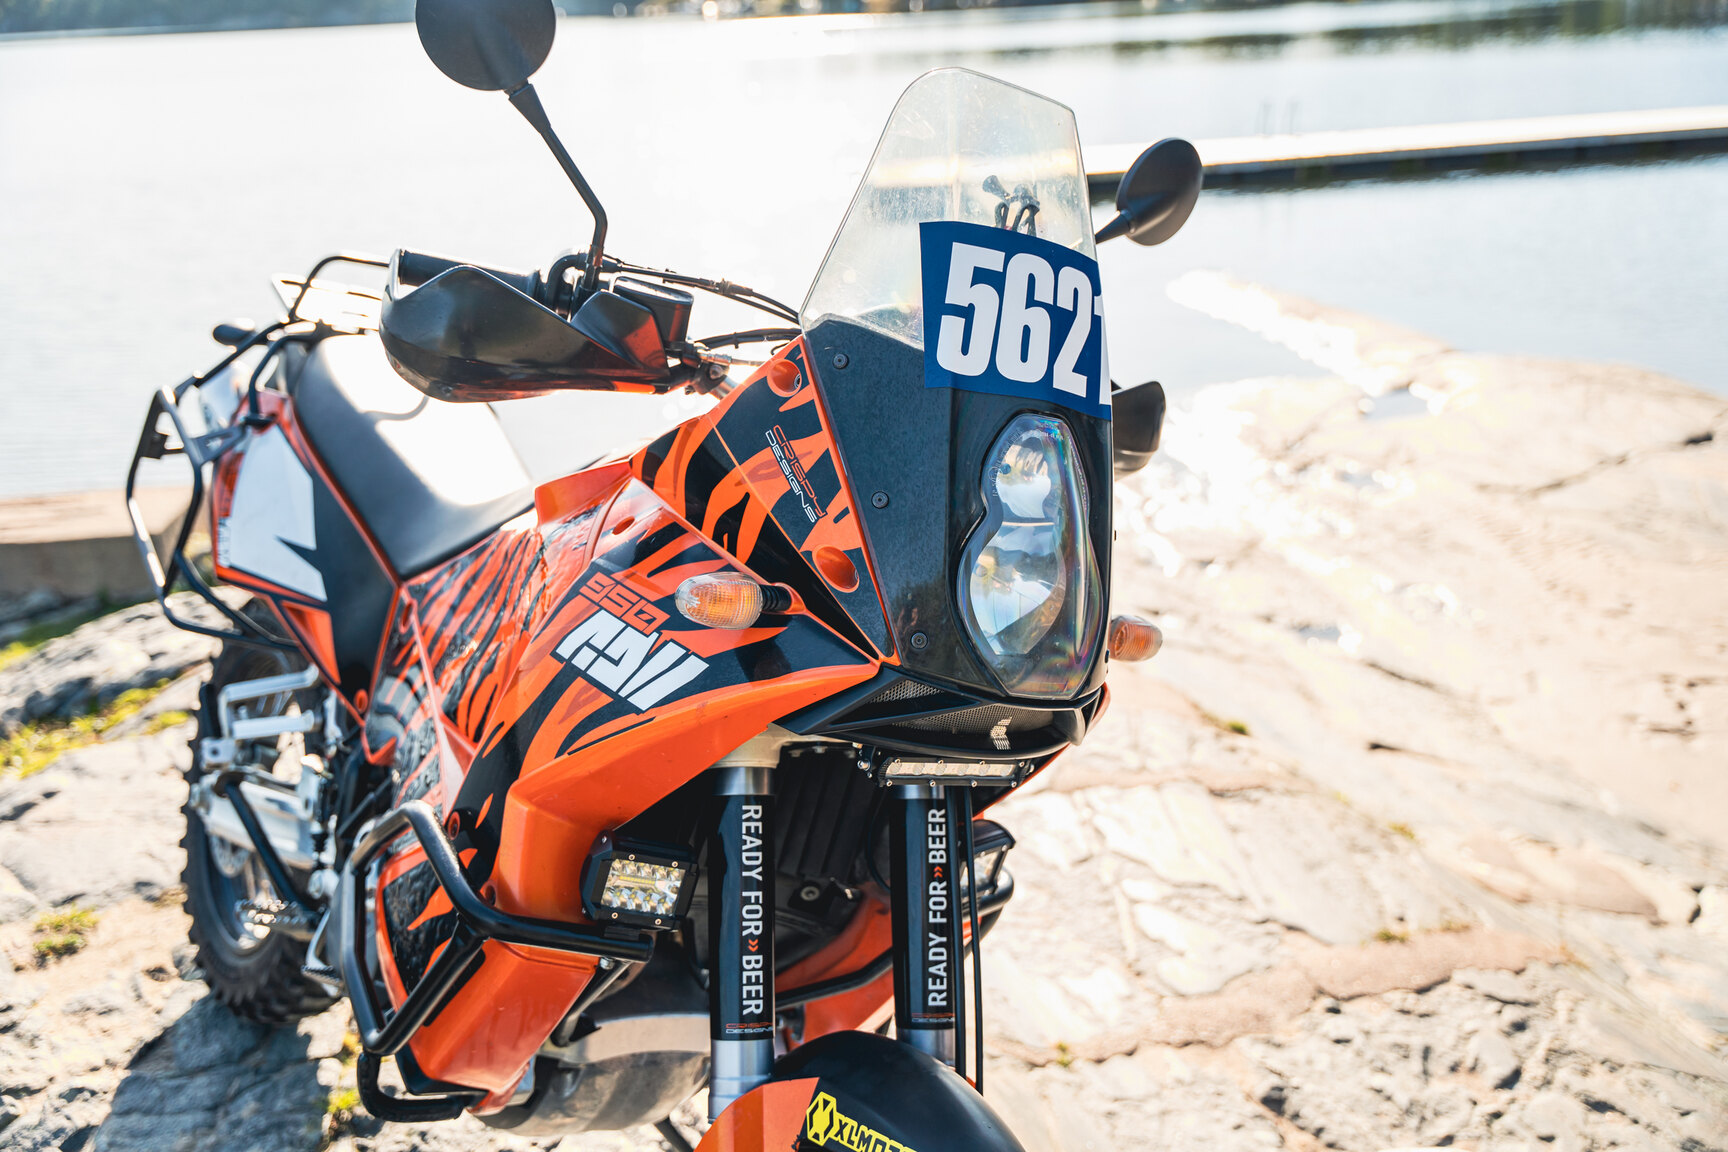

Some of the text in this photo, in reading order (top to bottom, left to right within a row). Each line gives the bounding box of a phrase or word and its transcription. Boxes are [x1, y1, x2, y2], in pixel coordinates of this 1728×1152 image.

[765, 429, 818, 523] DESIGNS
[772, 424, 826, 517] CRISPY
[927, 808, 947, 864] BEER
[741, 804, 764, 1016] READY FOR BEER
[928, 881, 948, 924] FOR
[927, 932, 948, 1007] READY
